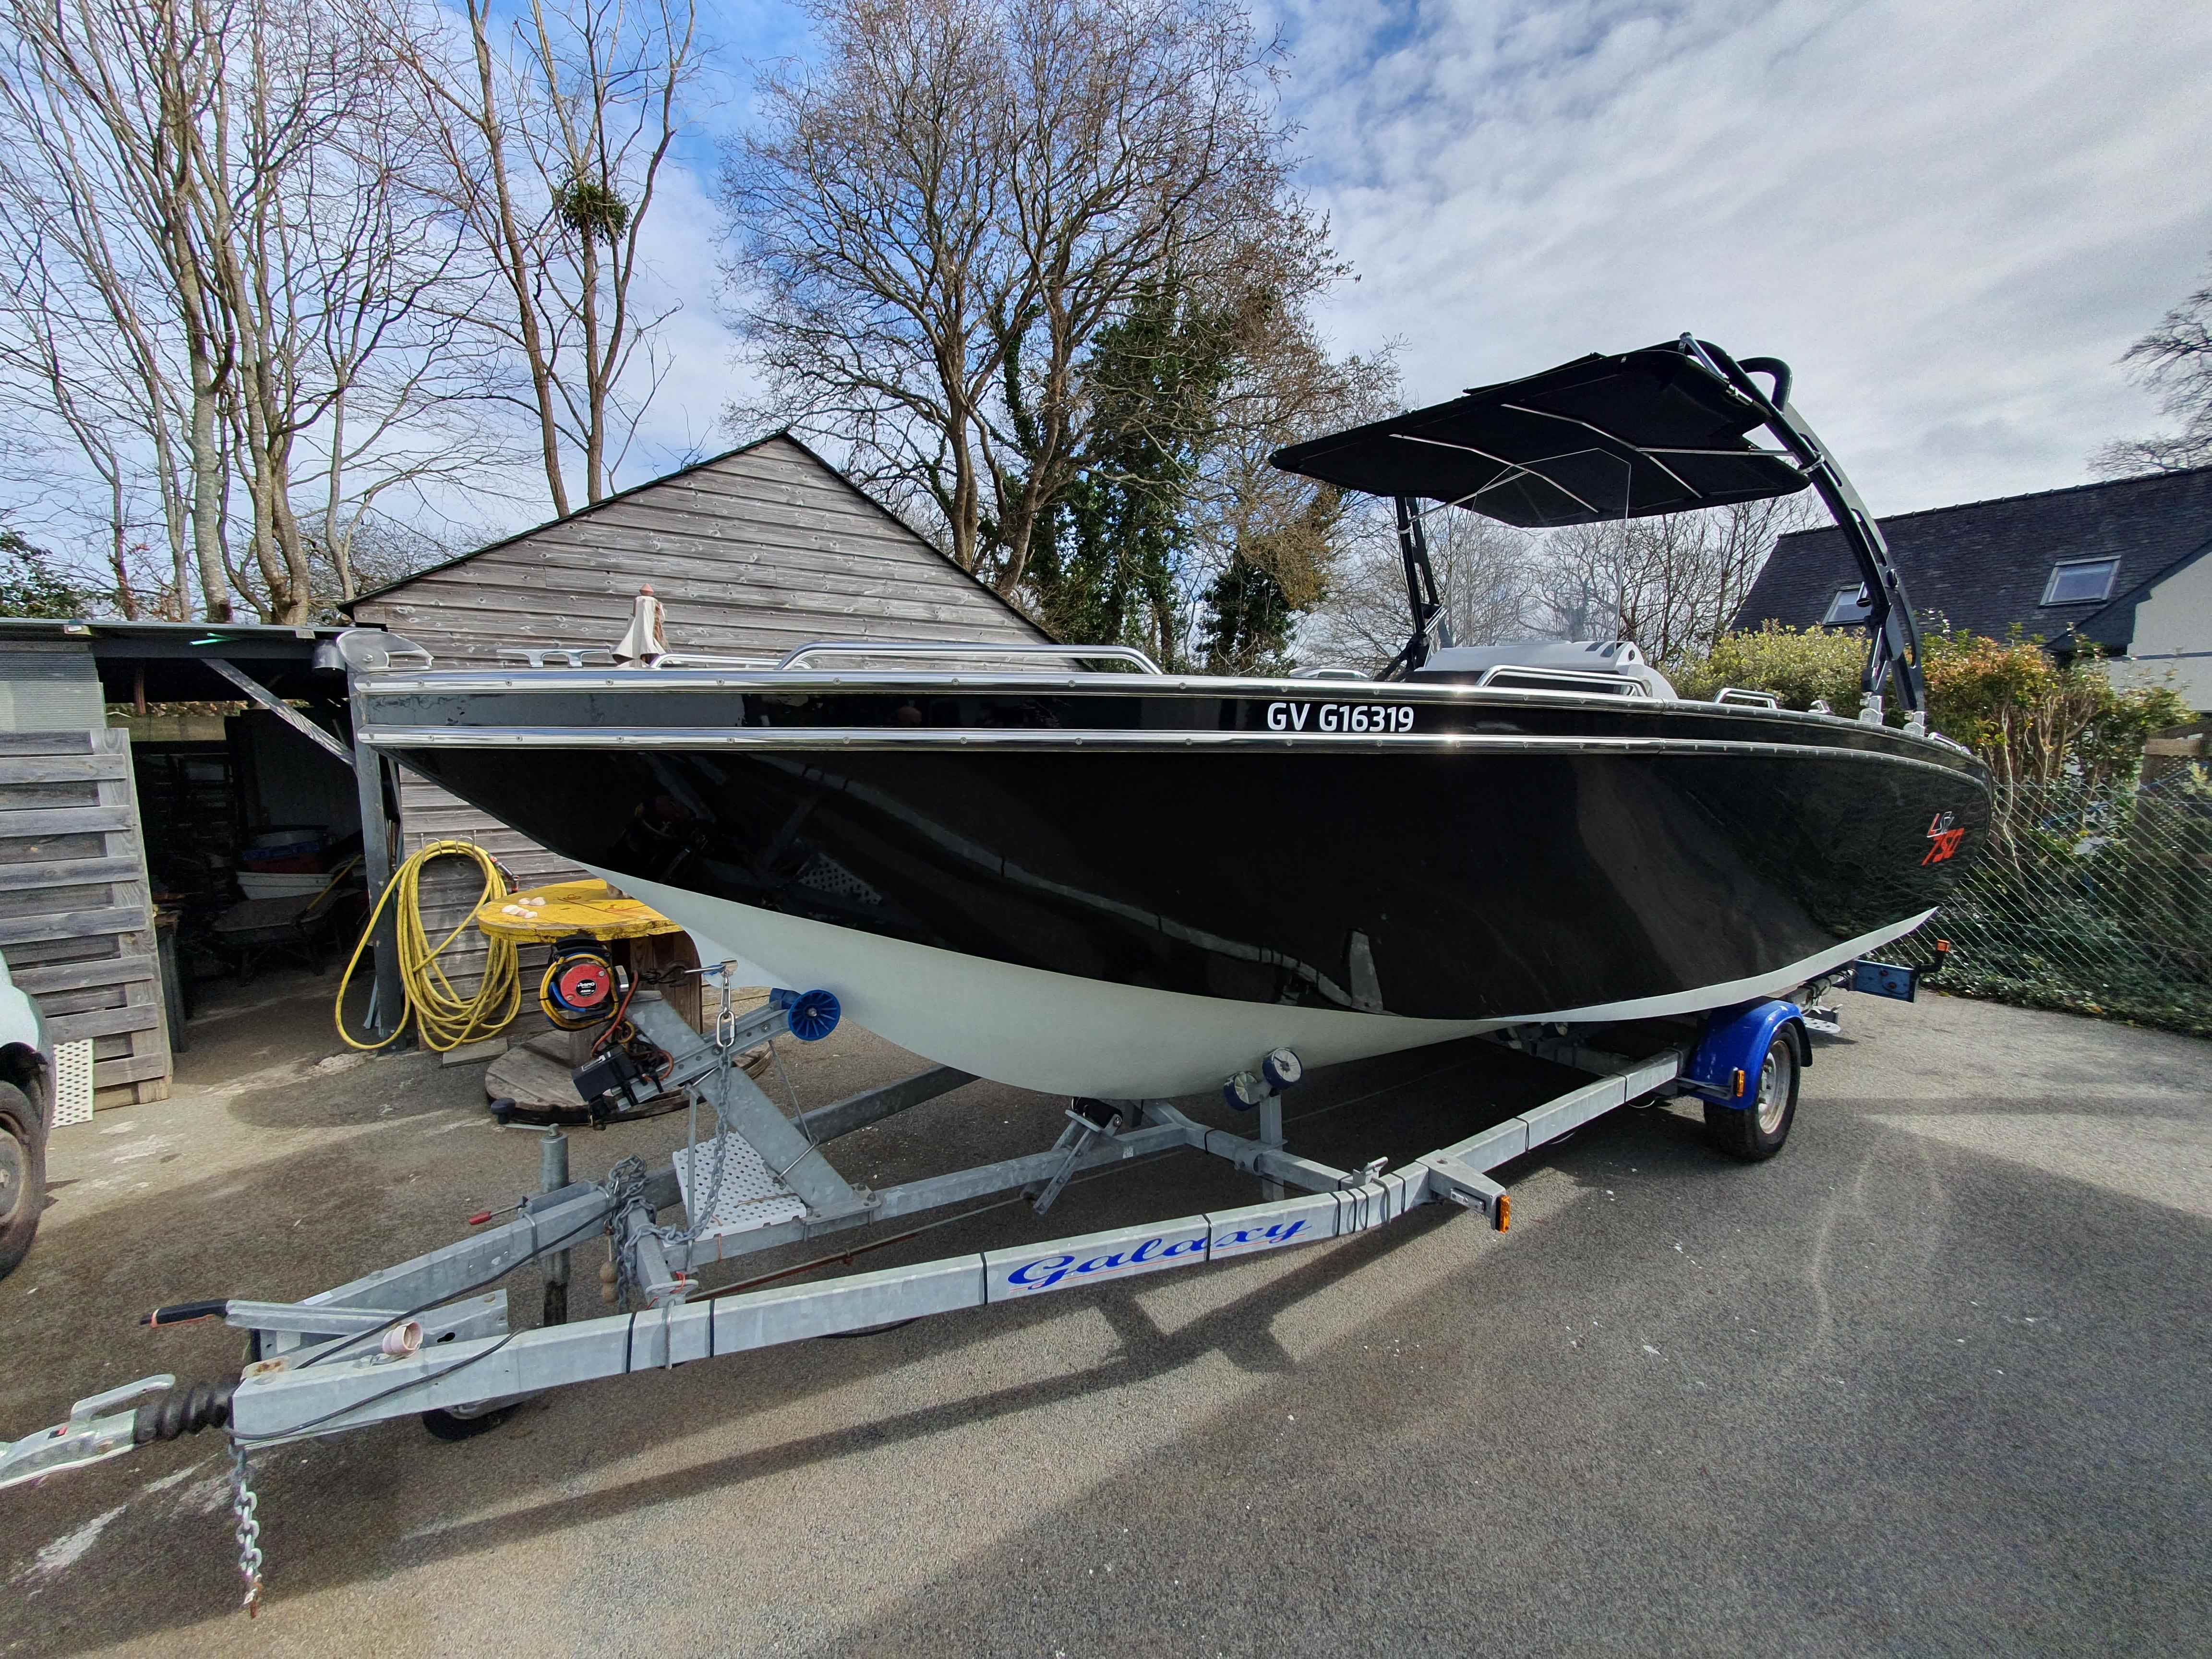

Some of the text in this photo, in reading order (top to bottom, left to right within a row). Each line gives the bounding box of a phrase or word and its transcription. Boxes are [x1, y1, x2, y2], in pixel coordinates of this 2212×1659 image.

[1267, 702, 1414, 732] GV G16319
[1008, 1219, 1312, 1290] Galaxy
